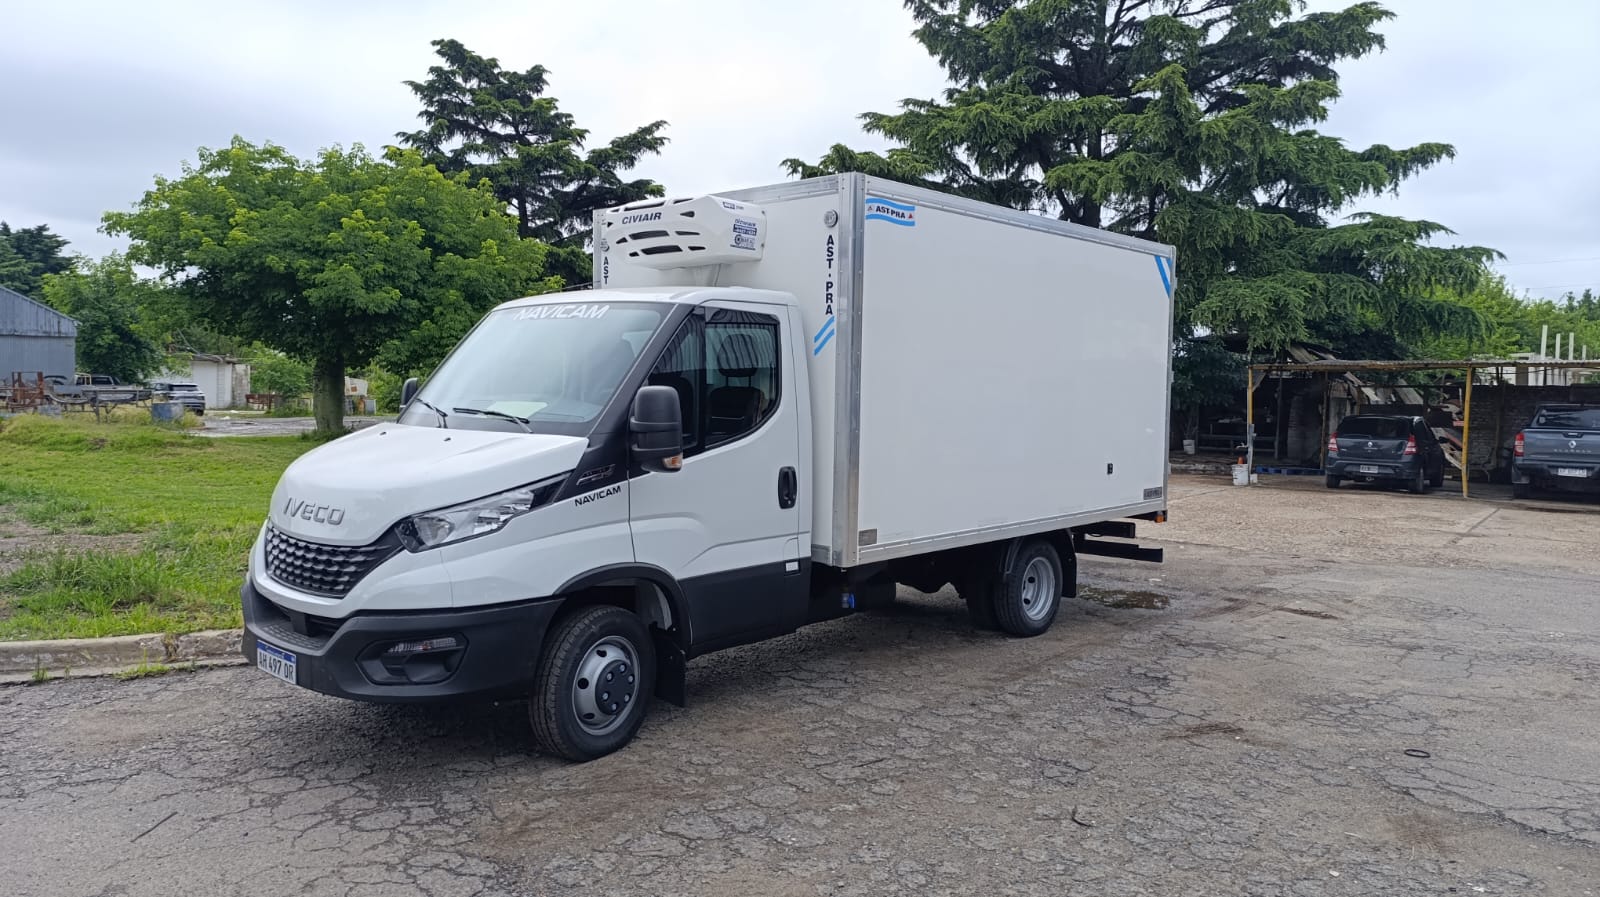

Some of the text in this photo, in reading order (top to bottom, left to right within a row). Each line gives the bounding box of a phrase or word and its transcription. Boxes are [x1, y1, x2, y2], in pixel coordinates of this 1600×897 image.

[622, 212, 662, 224] CIVIAIR
[513, 304, 610, 320] NAVICAM
[574, 485, 621, 506] NAVICAM
[283, 497, 345, 525] IVECO
[258, 651, 267, 669] AH
[269, 656, 281, 675] 497
